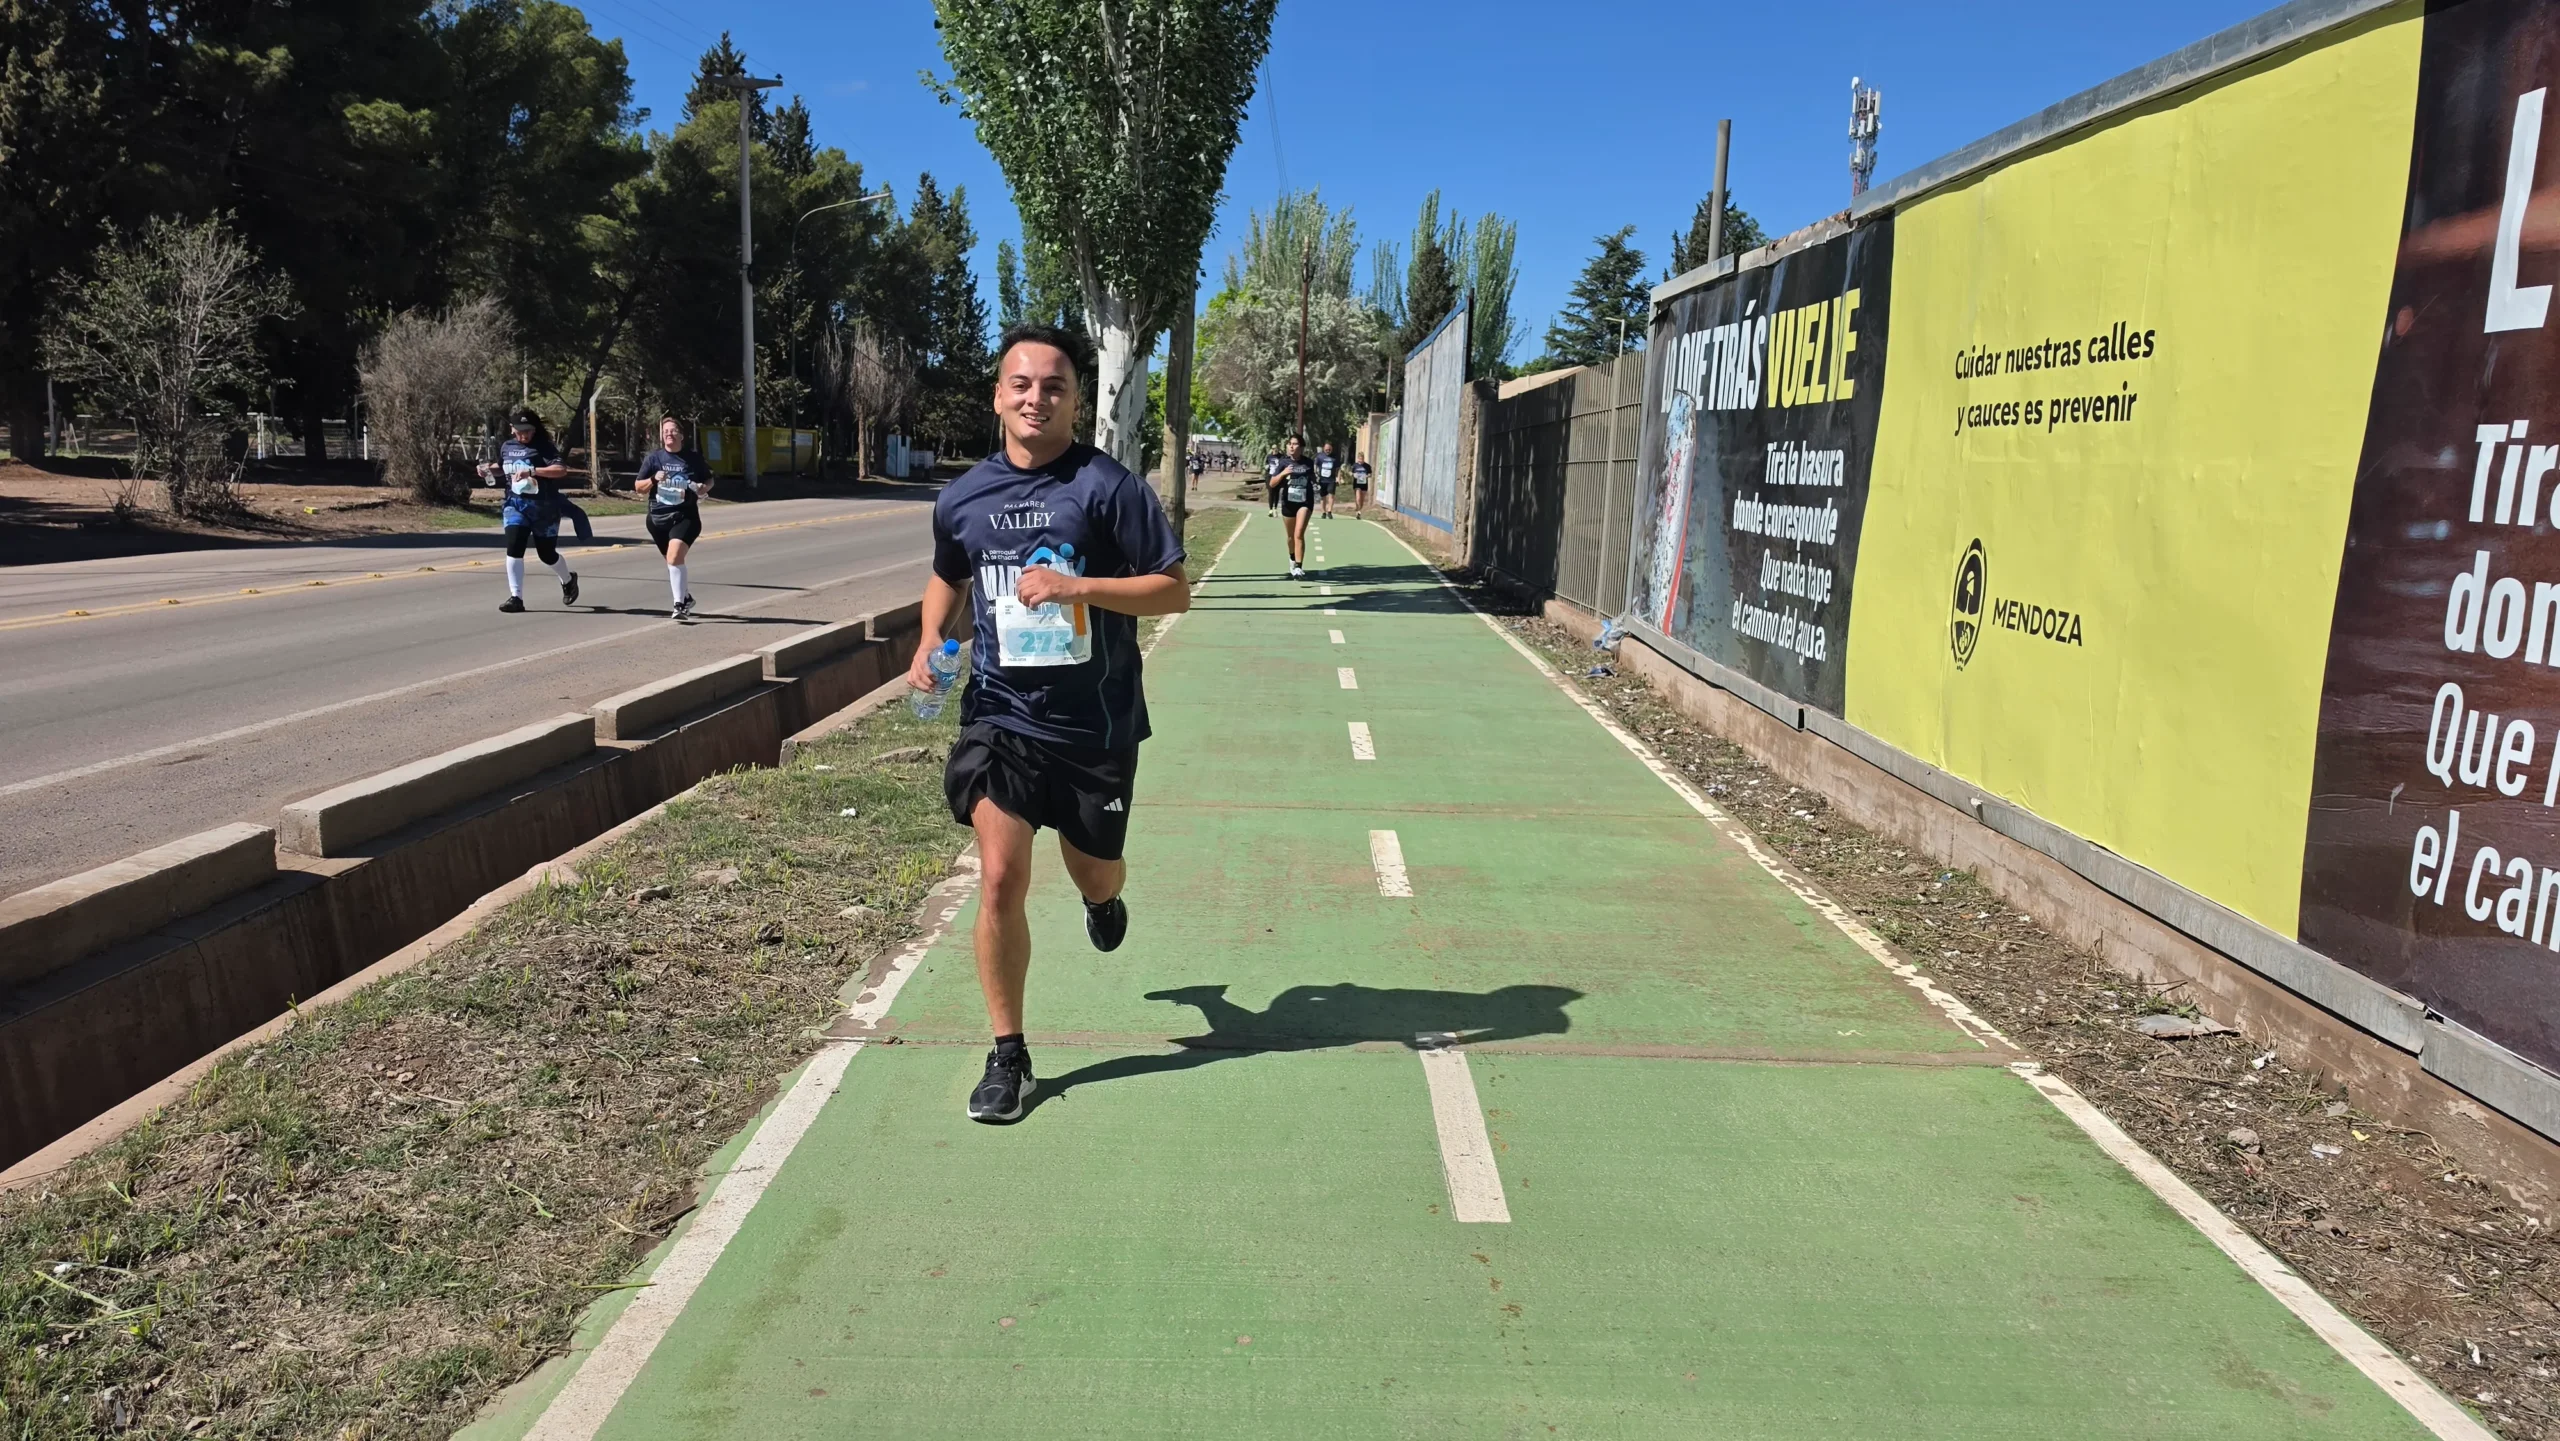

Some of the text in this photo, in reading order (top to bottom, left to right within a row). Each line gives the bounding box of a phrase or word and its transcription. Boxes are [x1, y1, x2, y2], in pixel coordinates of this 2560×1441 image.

[1677, 329, 1711, 411] QUE
[1708, 299, 1767, 411] TIRÁS
[1955, 320, 2156, 380] Cuidar nuestras calles
[1954, 380, 2138, 437] y cauces es prevenir
[1765, 440, 1844, 487] Tirá la basura
[2469, 420, 2560, 530] Tir
[989, 512, 1056, 530] VALLEY
[1003, 500, 1046, 510] PALMARES
[1733, 490, 1839, 551] donde corresponde
[1760, 548, 1832, 612] Que nada tape
[1731, 592, 1827, 666] el camino del agua.
[1992, 597, 2082, 647] MENDOZA
[2426, 682, 2535, 797] Que
[2410, 809, 2460, 906] el
